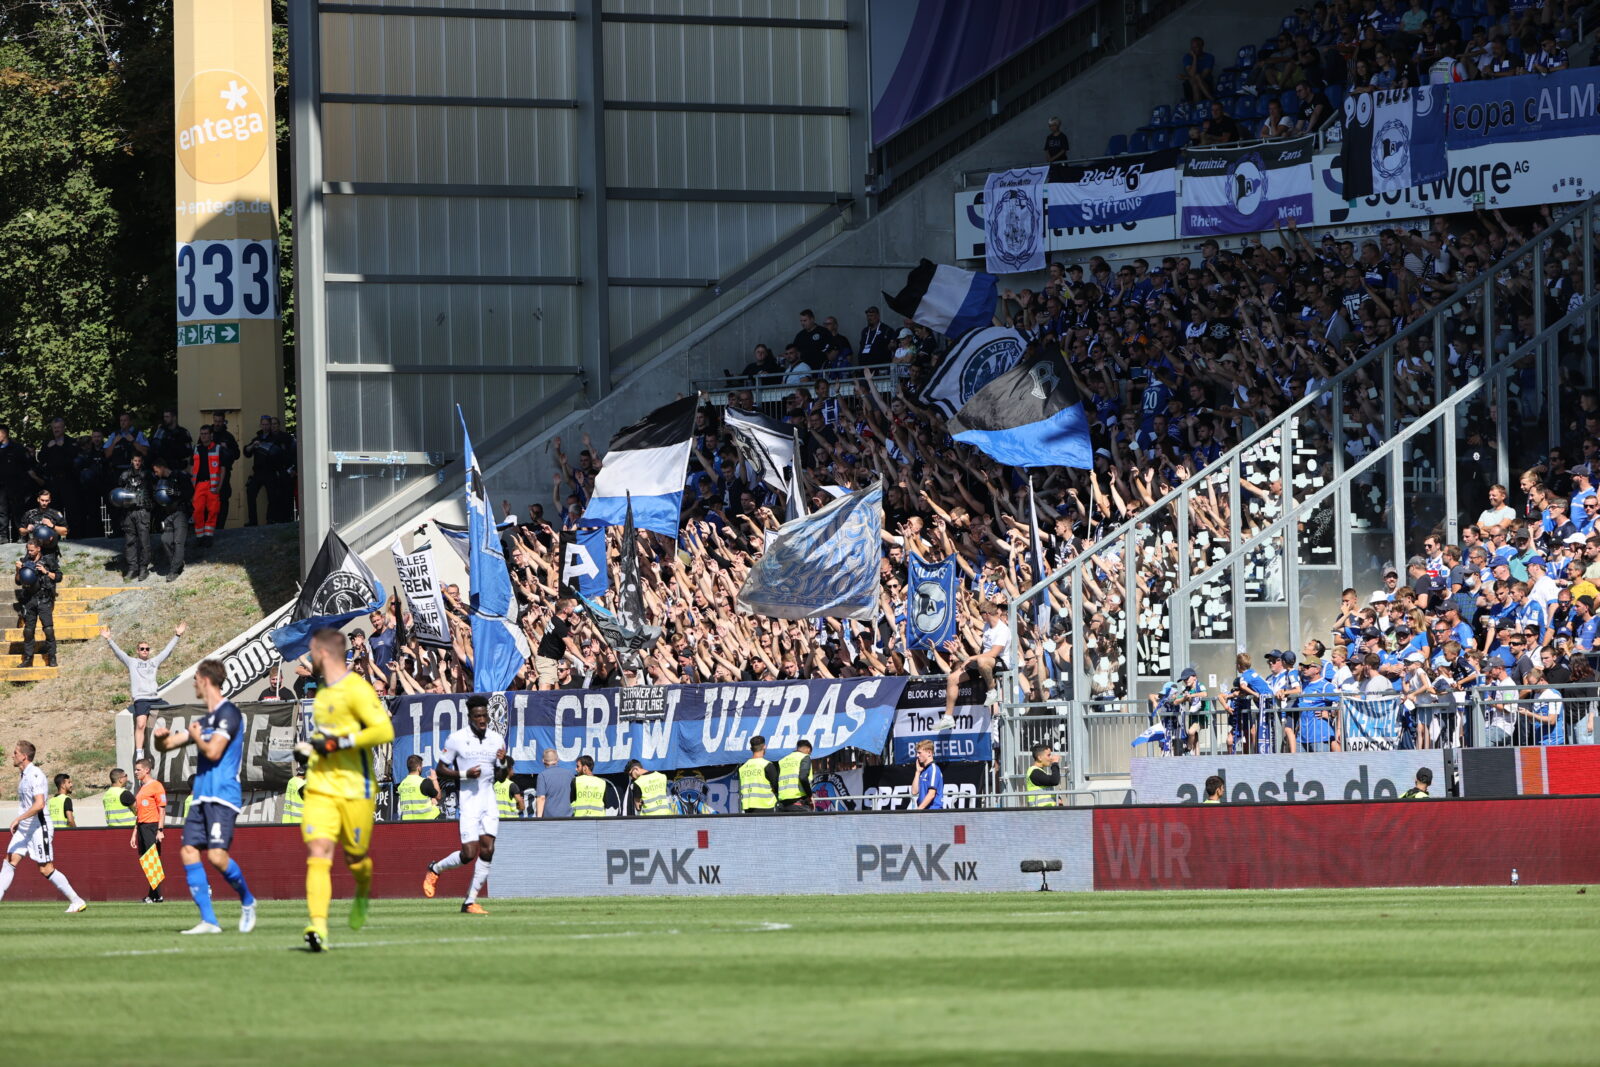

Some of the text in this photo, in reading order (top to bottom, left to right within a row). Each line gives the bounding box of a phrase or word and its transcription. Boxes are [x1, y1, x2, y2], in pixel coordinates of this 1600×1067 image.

[1376, 87, 1411, 107] PLUS
[1453, 83, 1600, 136] copa cALM
[179, 112, 264, 151] entega
[1189, 149, 1303, 170] Arminia Fans
[1514, 160, 1530, 174] AG
[1125, 163, 1144, 193] 6
[188, 200, 270, 217] entega.de
[1278, 205, 1303, 220] Main
[1143, 391, 1158, 410] 20
[397, 555, 427, 567] ALLES
[407, 564, 430, 578] WIR
[562, 542, 600, 587] A
[402, 577, 433, 593] BEN
[907, 690, 929, 700] BLOCK
[929, 690, 934, 699] 6
[409, 693, 537, 768] LOL
[701, 678, 883, 754] ULTRAS
[908, 710, 974, 733] The rm
[907, 739, 974, 758] BEFELD
[210, 822, 223, 839] 4
[1102, 821, 1193, 880] WIR
[606, 847, 721, 885] PEAK NX
[856, 842, 978, 882] PEAK NX
